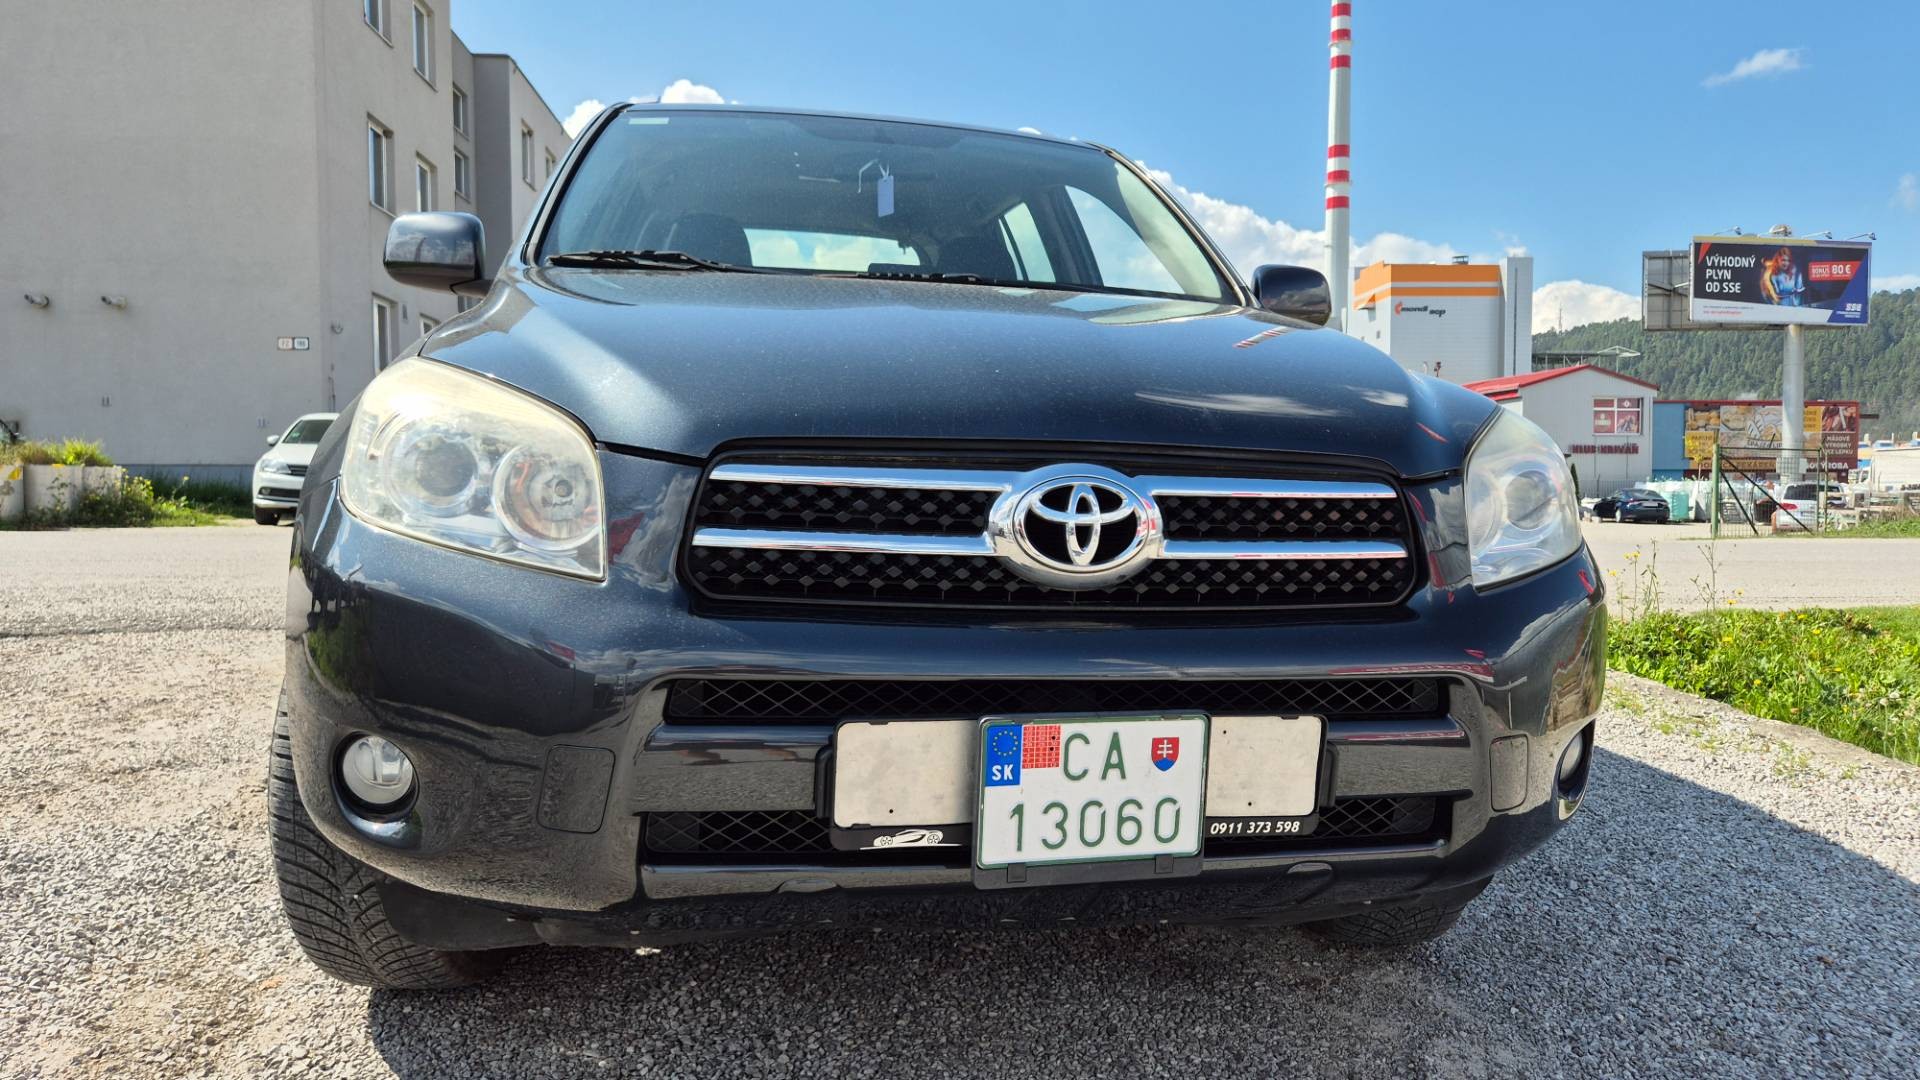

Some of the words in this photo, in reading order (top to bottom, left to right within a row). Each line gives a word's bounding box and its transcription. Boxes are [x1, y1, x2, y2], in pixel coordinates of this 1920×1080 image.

[1706, 254, 1756, 268] VÝHODNÝ
[1706, 269, 1731, 280] PLYN
[1832, 264, 1844, 274] 80
[1845, 264, 1852, 274] €
[1706, 282, 1720, 293] OD
[1723, 282, 1741, 293] SSE
[991, 764, 1014, 781] SK
[1063, 731, 1127, 782] CA
[1009, 797, 1181, 852] 13060
[1210, 822, 1243, 835] 0911
[1246, 821, 1272, 834] 373
[1275, 820, 1301, 833] 598
